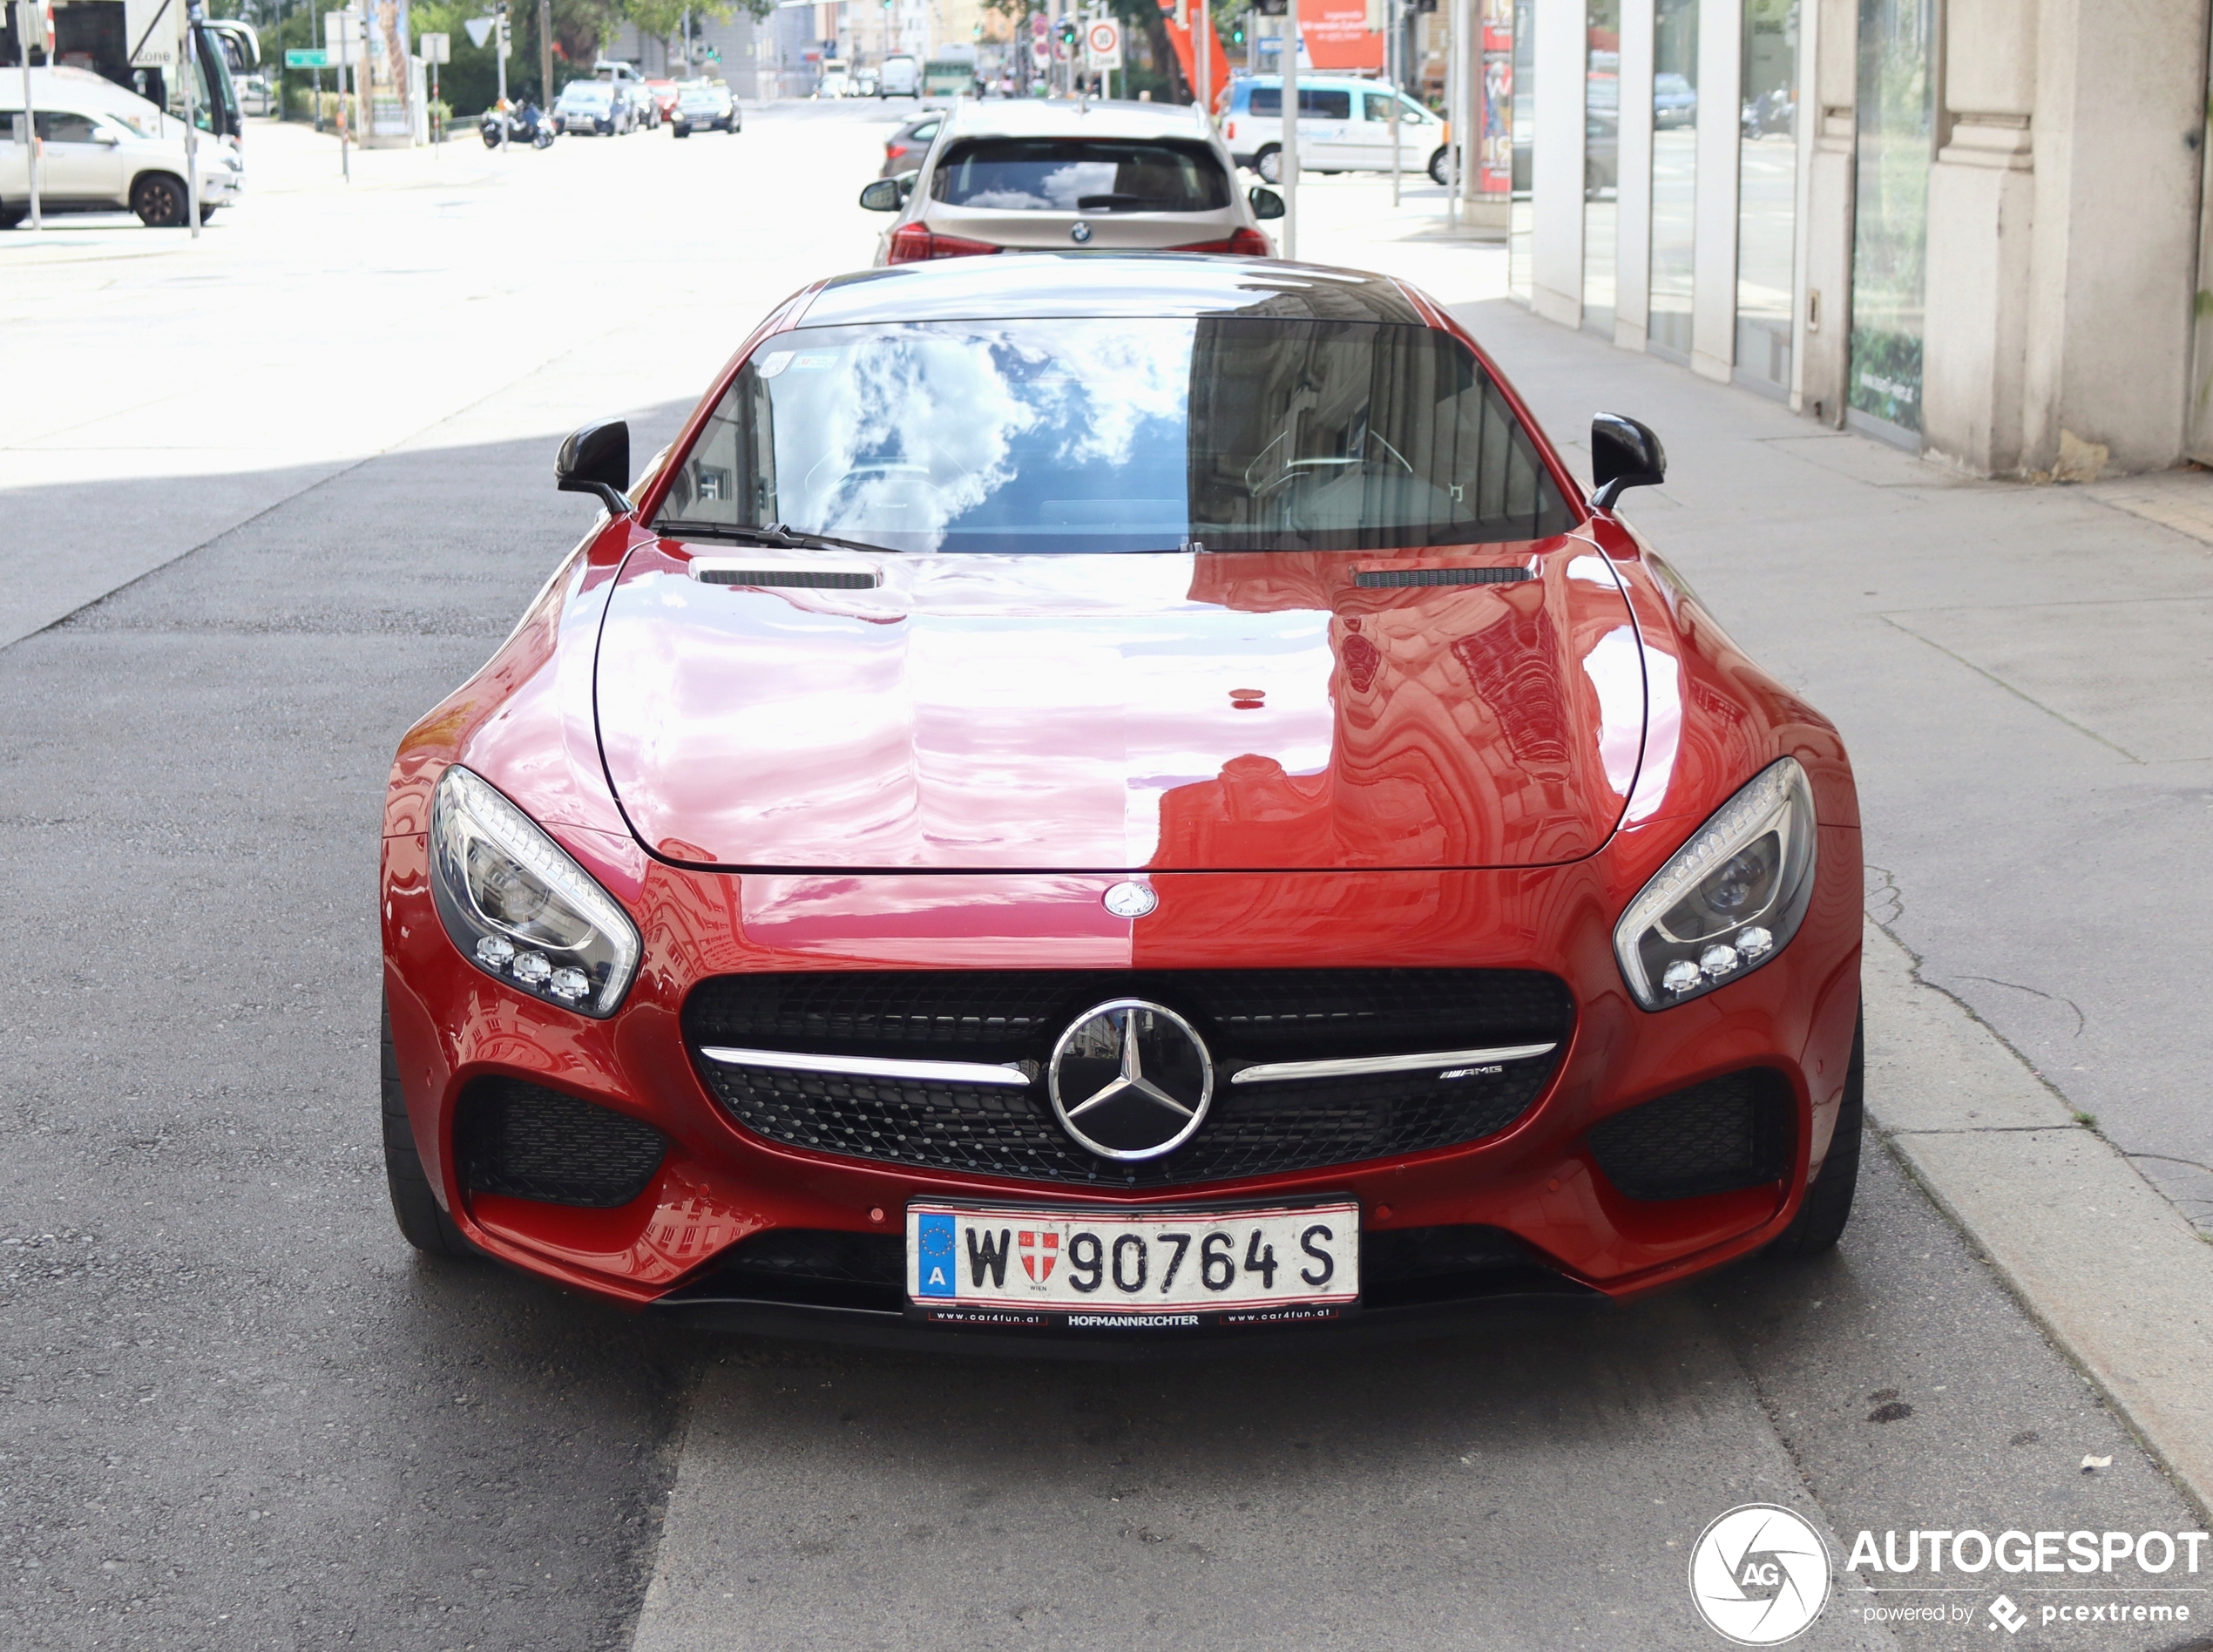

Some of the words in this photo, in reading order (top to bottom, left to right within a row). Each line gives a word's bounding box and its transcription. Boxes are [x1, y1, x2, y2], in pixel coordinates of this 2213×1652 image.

[136, 47, 171, 62] Zone
[965, 1227, 1011, 1288] W
[1068, 1228, 1278, 1294] 90764
[1300, 1224, 1334, 1286] S
[928, 1266, 946, 1285] A
[937, 1311, 1039, 1324] www.car4fun.at
[1068, 1315, 1199, 1327] HOFMANNRICHTER
[1228, 1308, 1330, 1322] www.car4fun.at
